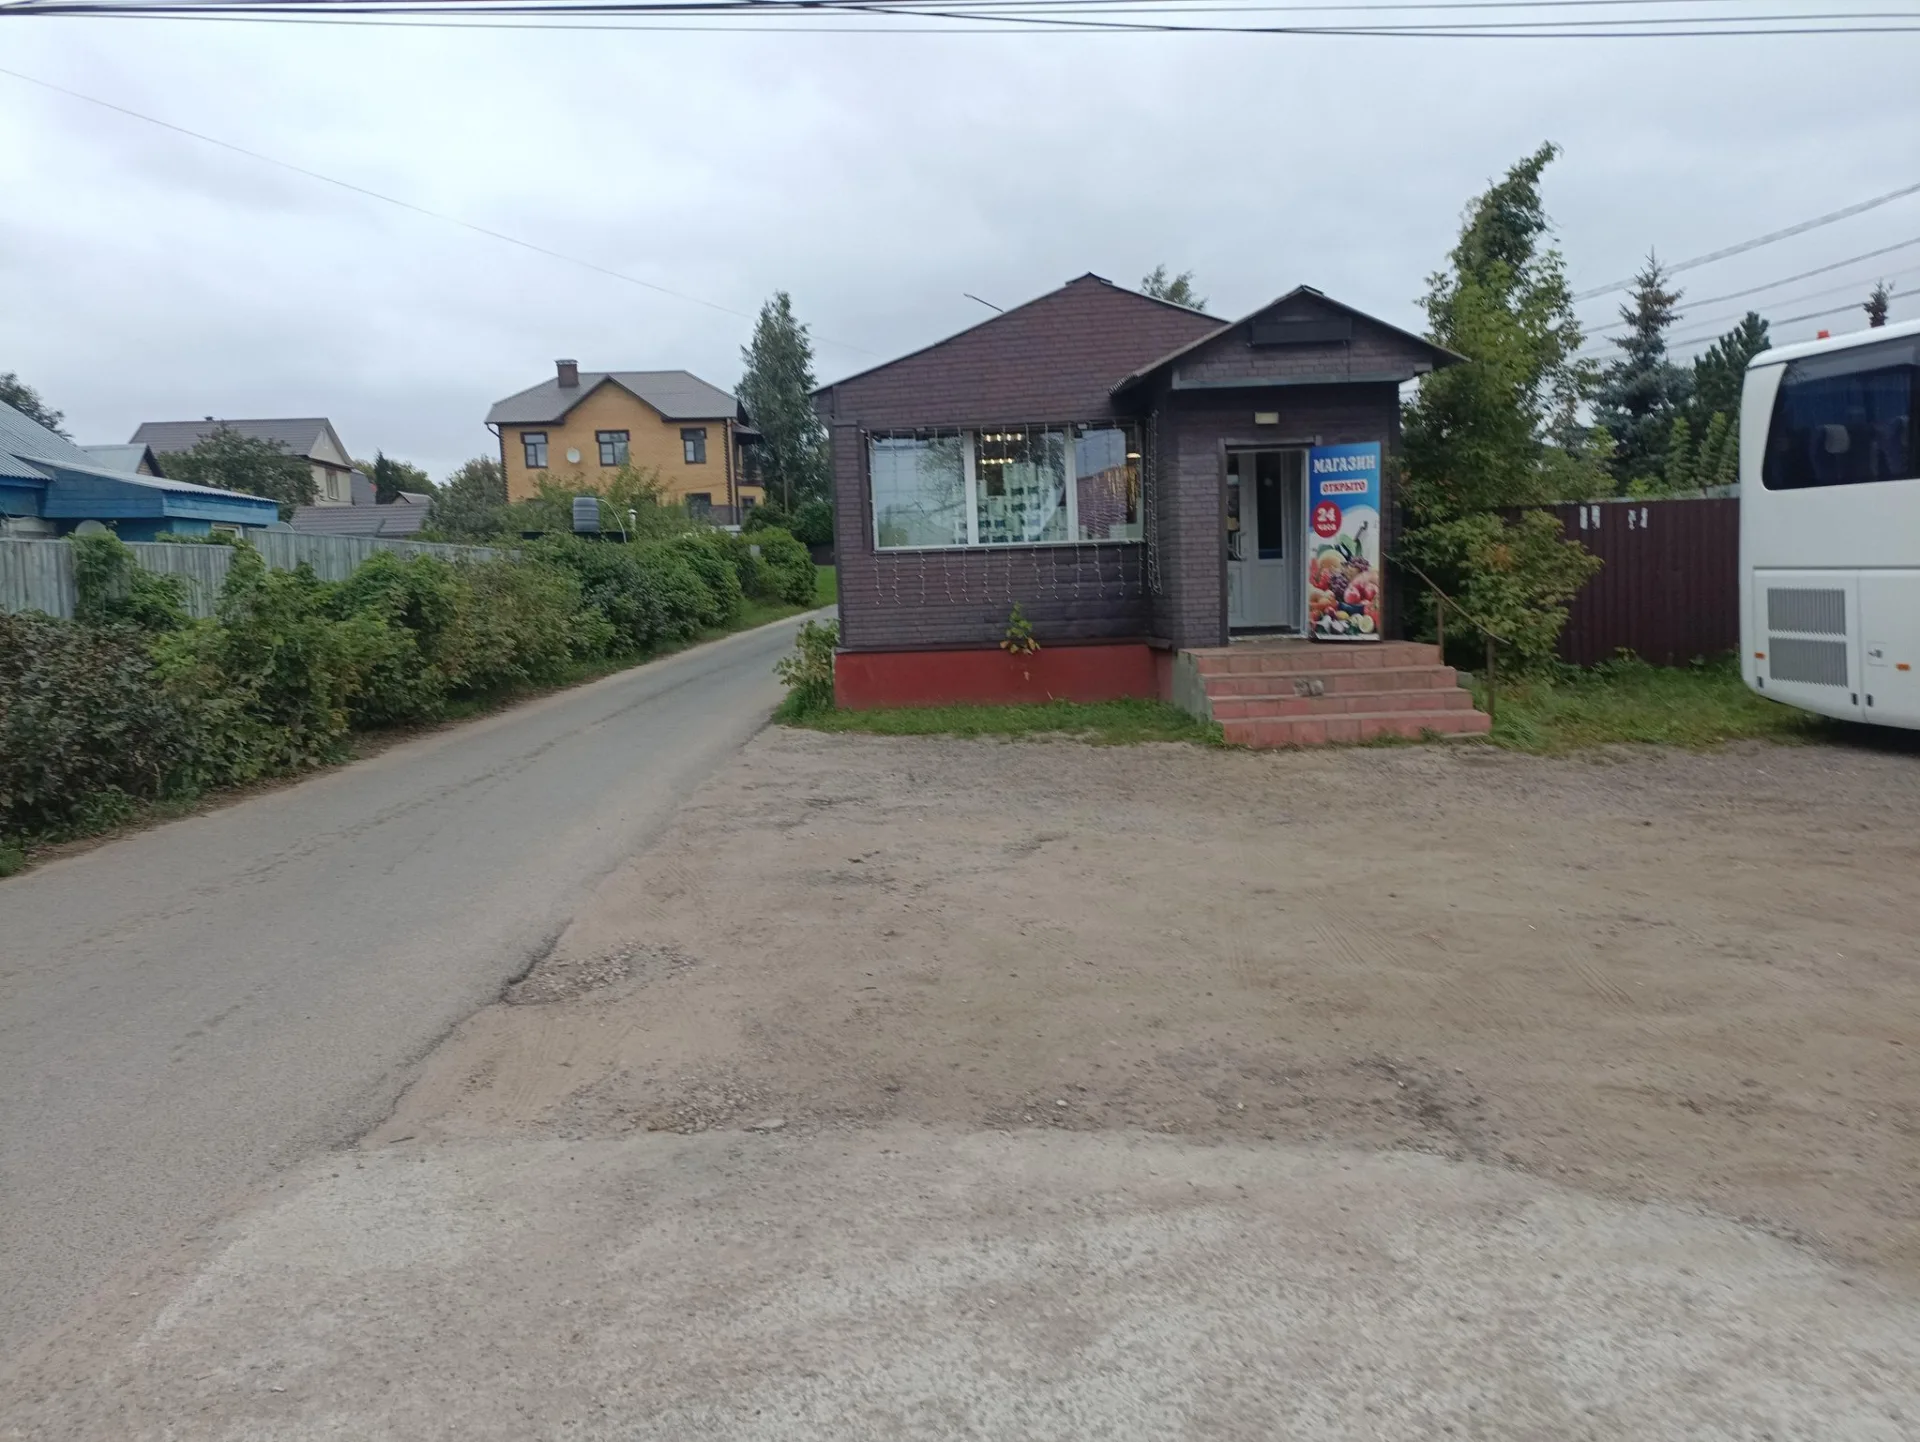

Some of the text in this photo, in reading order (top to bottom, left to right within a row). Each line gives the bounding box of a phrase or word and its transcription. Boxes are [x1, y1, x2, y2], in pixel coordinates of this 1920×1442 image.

[1313, 455, 1376, 473] МАГАЗИН
[1323, 481, 1365, 493] ОТКРЫТО
[1317, 507, 1336, 521] 24
